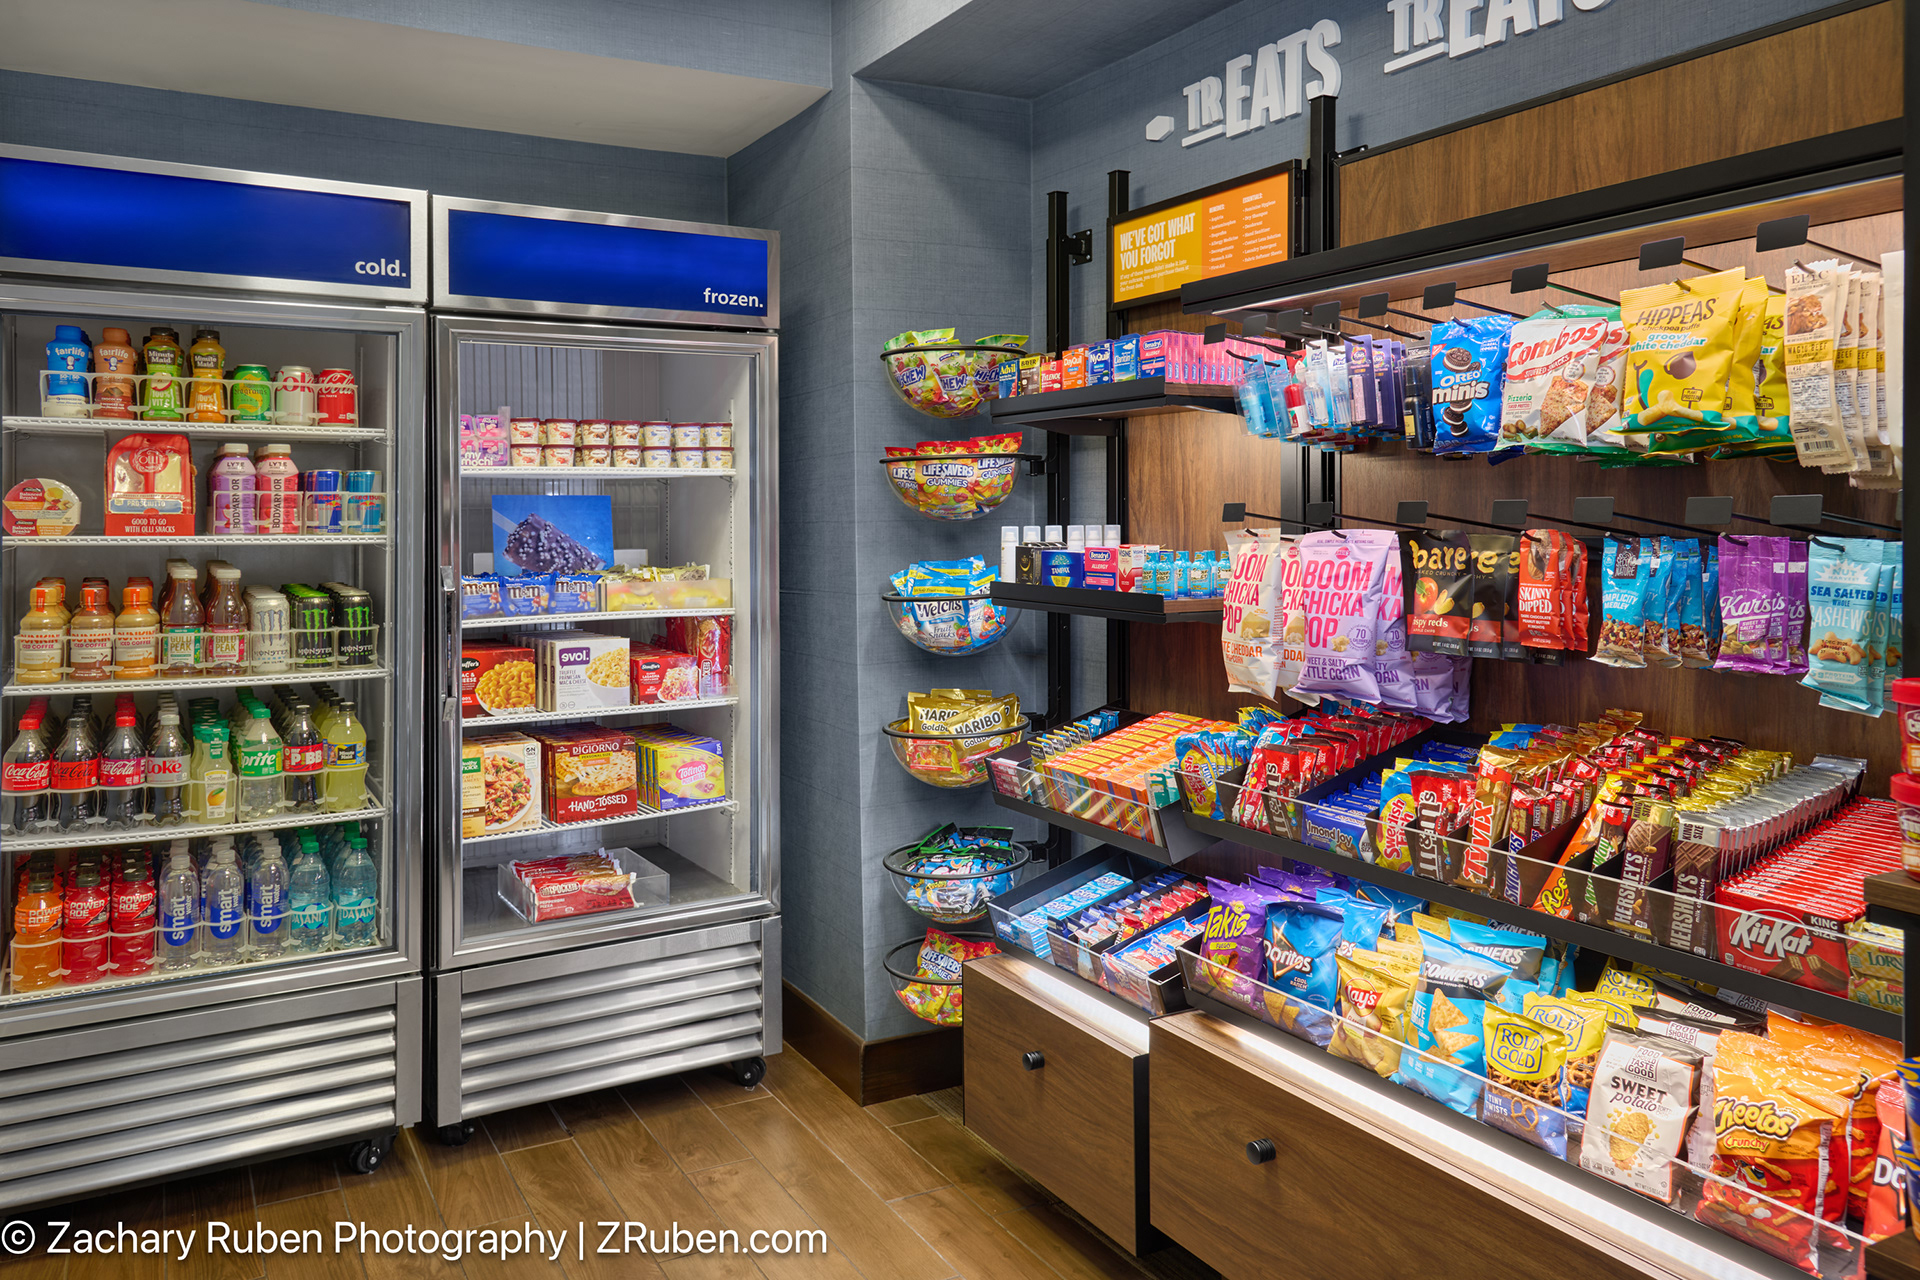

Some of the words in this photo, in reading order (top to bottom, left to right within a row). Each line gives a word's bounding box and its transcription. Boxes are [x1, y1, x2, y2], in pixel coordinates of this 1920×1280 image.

[1186, 19, 1341, 138] TREATS
[1120, 227, 1148, 252] WE'VE
[1150, 222, 1166, 244] GOT
[1168, 212, 1196, 238] WHAT
[1120, 250, 1138, 270] YOU
[1140, 239, 1176, 266] FORGOT
[354, 258, 407, 278] cold.
[703, 288, 764, 308] frozen.
[1636, 298, 1718, 327] HIPPEAS
[1642, 324, 1678, 332] chickpea
[1680, 322, 1701, 332] puffs
[1143, 340, 1162, 350] Benadryl
[1508, 321, 1604, 369] Combos
[1630, 341, 1658, 352] white
[1660, 337, 1704, 350] cheddar
[1647, 332, 1690, 344] groovy
[55, 347, 86, 358] fairlife
[100, 348, 129, 359] fairlife
[148, 350, 175, 358] Minute
[151, 356, 172, 364] Maid
[1090, 350, 1110, 362] NyQuil
[1064, 355, 1082, 368] DayQuil
[1000, 364, 1016, 376] Advil
[1440, 371, 1480, 388] OREO
[152, 390, 171, 398] 100%
[234, 388, 267, 396] Seagram's
[1432, 381, 1490, 405] minis
[1508, 394, 1532, 402] Pizzeria
[138, 455, 159, 464] OLLI
[461, 458, 493, 466] mochi
[465, 452, 481, 461] my
[922, 463, 974, 478] LIFESAVERS
[926, 478, 968, 488] GUMMIES
[232, 478, 240, 529] BODYARMOR
[272, 478, 282, 529] BODYARMOR
[125, 525, 140, 533] WITH
[141, 525, 154, 533] OLLI
[155, 525, 176, 533] SNACKS
[1089, 551, 1111, 561] Benadryl
[1409, 540, 1467, 570] bare
[1051, 566, 1070, 575] TAMPAX
[1304, 560, 1374, 592] BOOM
[1832, 568, 1857, 576] NUT
[1223, 581, 1259, 606] CHICKA
[1520, 586, 1552, 600] SKINNY
[1810, 586, 1831, 597] SEA
[1834, 588, 1875, 600] SALTED
[1304, 591, 1364, 617] CHICKA
[1520, 599, 1552, 613] DIPPED
[1604, 602, 1629, 610] MEDLEY
[1832, 599, 1850, 607] WHOLE
[1223, 604, 1243, 634] POP
[1810, 605, 1871, 636] CASHEWS
[929, 631, 956, 639] Snacks
[934, 625, 952, 633] Fruit
[1304, 616, 1339, 649] POP
[1356, 628, 1366, 639] 70
[1391, 631, 1400, 640] 70
[170, 643, 192, 651] PEAK
[1231, 644, 1263, 659] CHEDDAR
[561, 650, 589, 662] evol.
[1328, 658, 1347, 668] SALTY
[1329, 665, 1361, 681] CORN
[954, 712, 1002, 734] HARIBO
[147, 760, 182, 774] Coke
[241, 752, 276, 768] Sprite
[4, 764, 49, 779] Coca-Cola
[678, 764, 707, 778] Totino's
[568, 794, 628, 812] HAND-TOSSED
[1633, 801, 1643, 820] KING
[1383, 798, 1406, 860] Swedish
[1682, 822, 1693, 841] KING
[1693, 825, 1704, 840] SIZE
[1336, 827, 1353, 848] Joy
[1463, 799, 1494, 878] TWIX
[70, 900, 105, 911] POWER
[119, 893, 153, 904] POWER
[260, 884, 274, 927] smart
[170, 896, 185, 940] smart
[218, 888, 232, 933] smart
[343, 908, 373, 919] DASANI
[1670, 872, 1698, 949] HERSHEY'S
[1203, 904, 1251, 942] Takis
[1810, 916, 1838, 929] KING
[921, 948, 962, 972] LIFESAVERS
[1264, 940, 1314, 974] Doritos
[920, 962, 952, 980] GUMMIES
[1423, 960, 1490, 988] CORNERS
[1290, 979, 1308, 990] RANCH
[1293, 976, 1307, 985] COOL
[1604, 967, 1650, 994] ROLD
[1347, 986, 1378, 1010] Lay's
[1686, 1004, 1714, 1017] FOOD
[1533, 1008, 1579, 1032] ROLD
[1669, 1023, 1696, 1034] FOOD
[1669, 1029, 1695, 1041] SHOULD
[1501, 1028, 1540, 1052] ROLD
[1497, 1045, 1536, 1069] GOLD
[1637, 1046, 1661, 1058] FOOD
[1628, 1065, 1655, 1079] GOOD
[1631, 1058, 1655, 1071] TASTE
[1611, 1075, 1668, 1104] SWEET
[1488, 1094, 1503, 1105] TINY
[1610, 1090, 1657, 1113] potato
[1486, 1101, 1508, 1116] TWISTS
[1716, 1099, 1798, 1140] Cheetos
[1724, 1134, 1770, 1153] Crunchy
